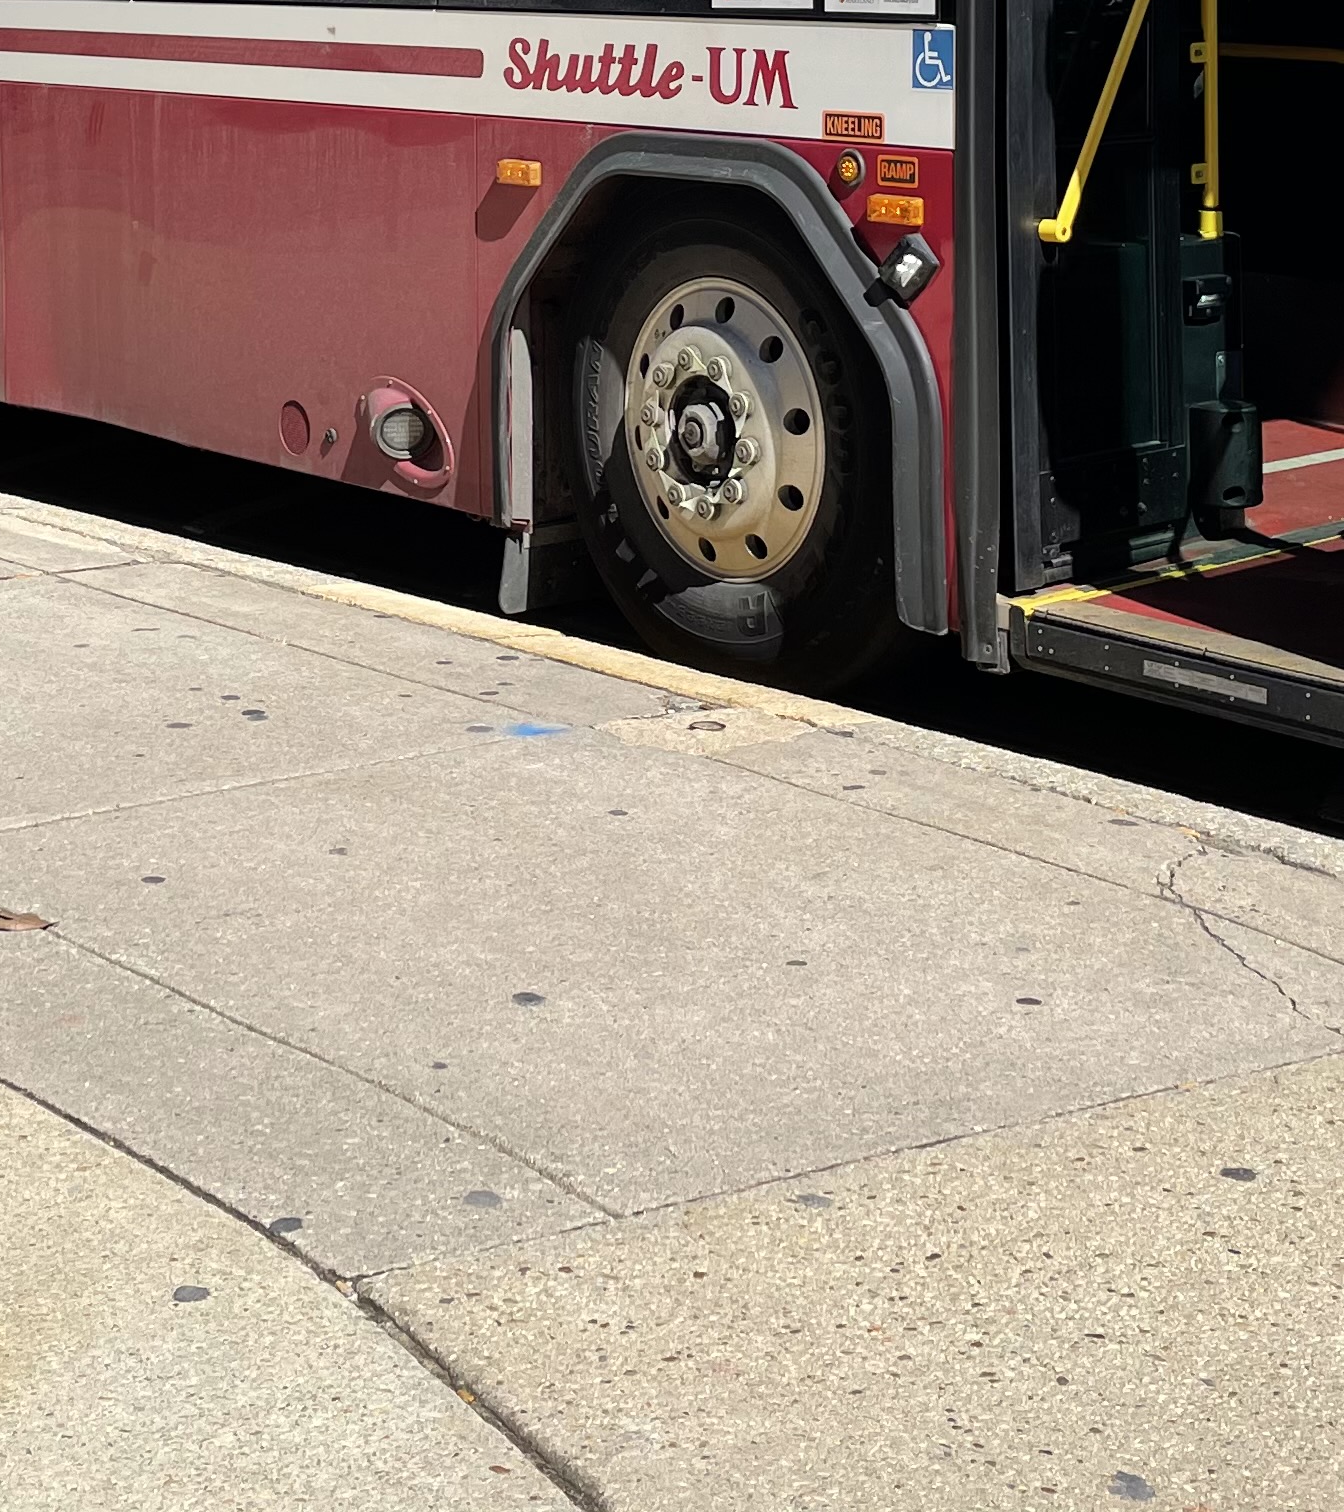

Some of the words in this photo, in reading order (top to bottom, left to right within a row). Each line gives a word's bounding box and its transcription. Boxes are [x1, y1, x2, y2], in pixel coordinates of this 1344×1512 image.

[503, 37, 798, 109] Shuttle-UM
[826, 116, 880, 137] KNEELING
[881, 161, 914, 180] RAMP
